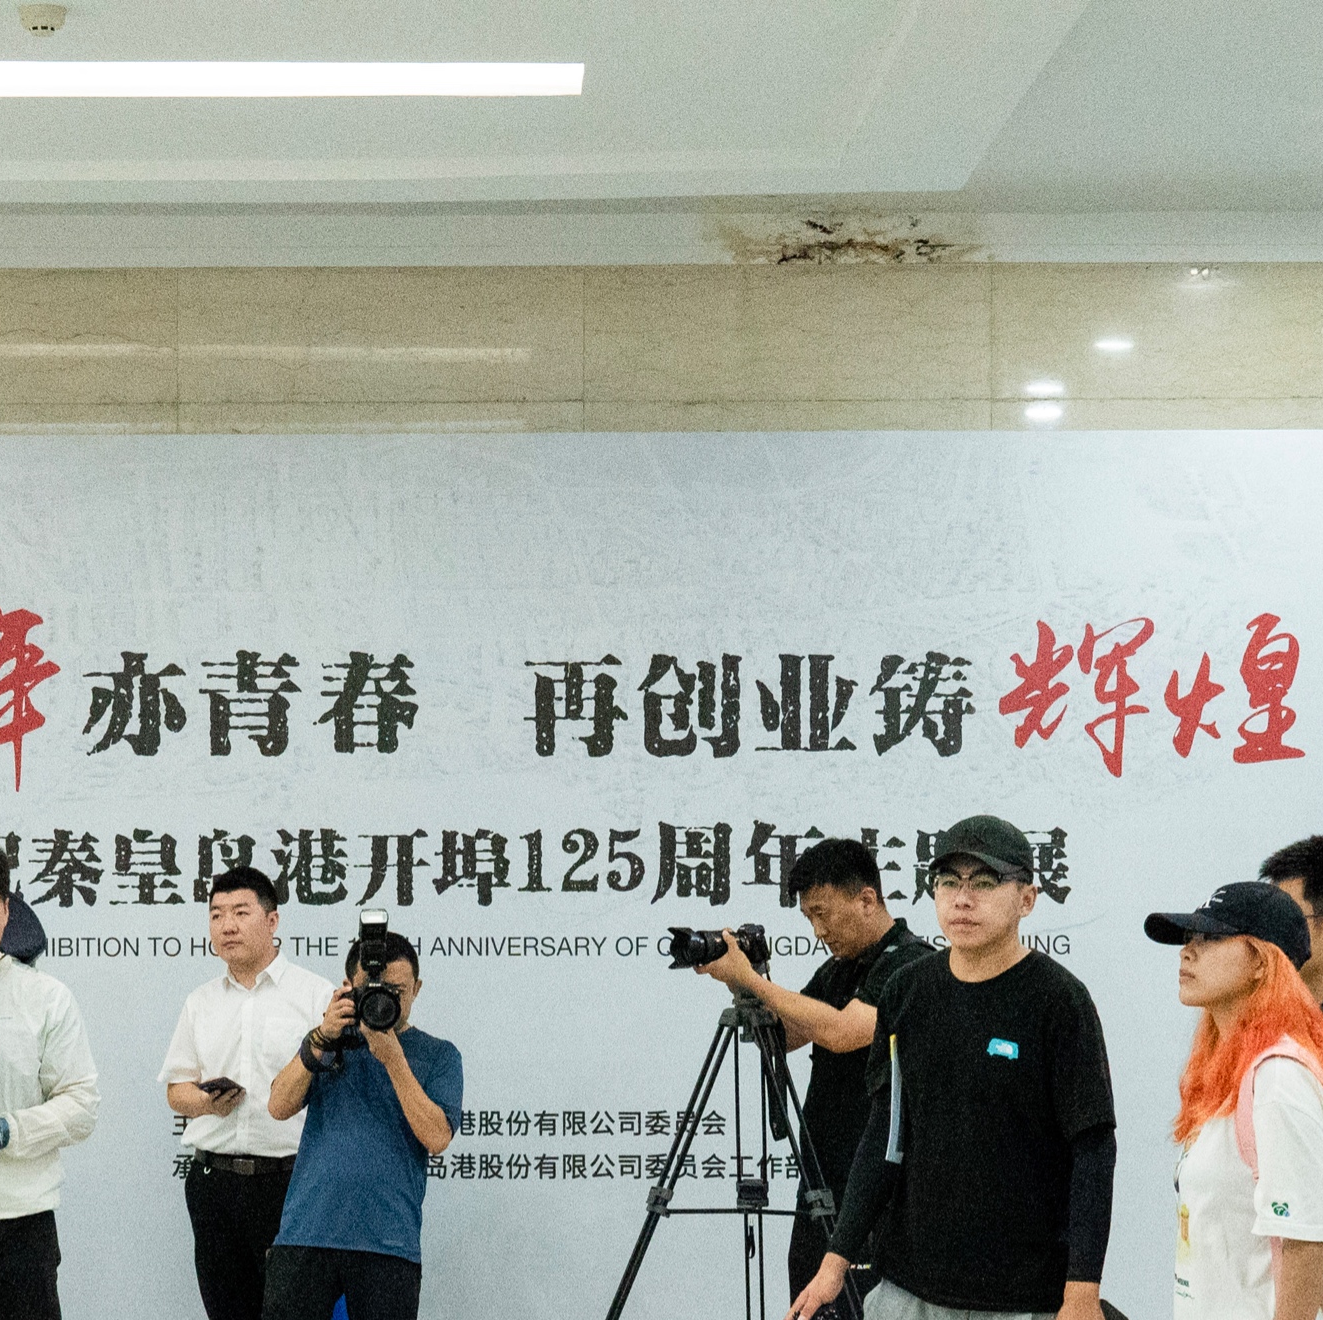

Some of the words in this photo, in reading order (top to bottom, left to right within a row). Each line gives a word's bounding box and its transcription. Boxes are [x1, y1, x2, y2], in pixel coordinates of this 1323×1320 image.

[523, 611, 1307, 778] 再创业铸辉煌
[148, 936, 182, 958] TO
[290, 936, 339, 957] THE
[429, 936, 607, 957] ANNIVERSARY
[615, 936, 649, 957] OF
